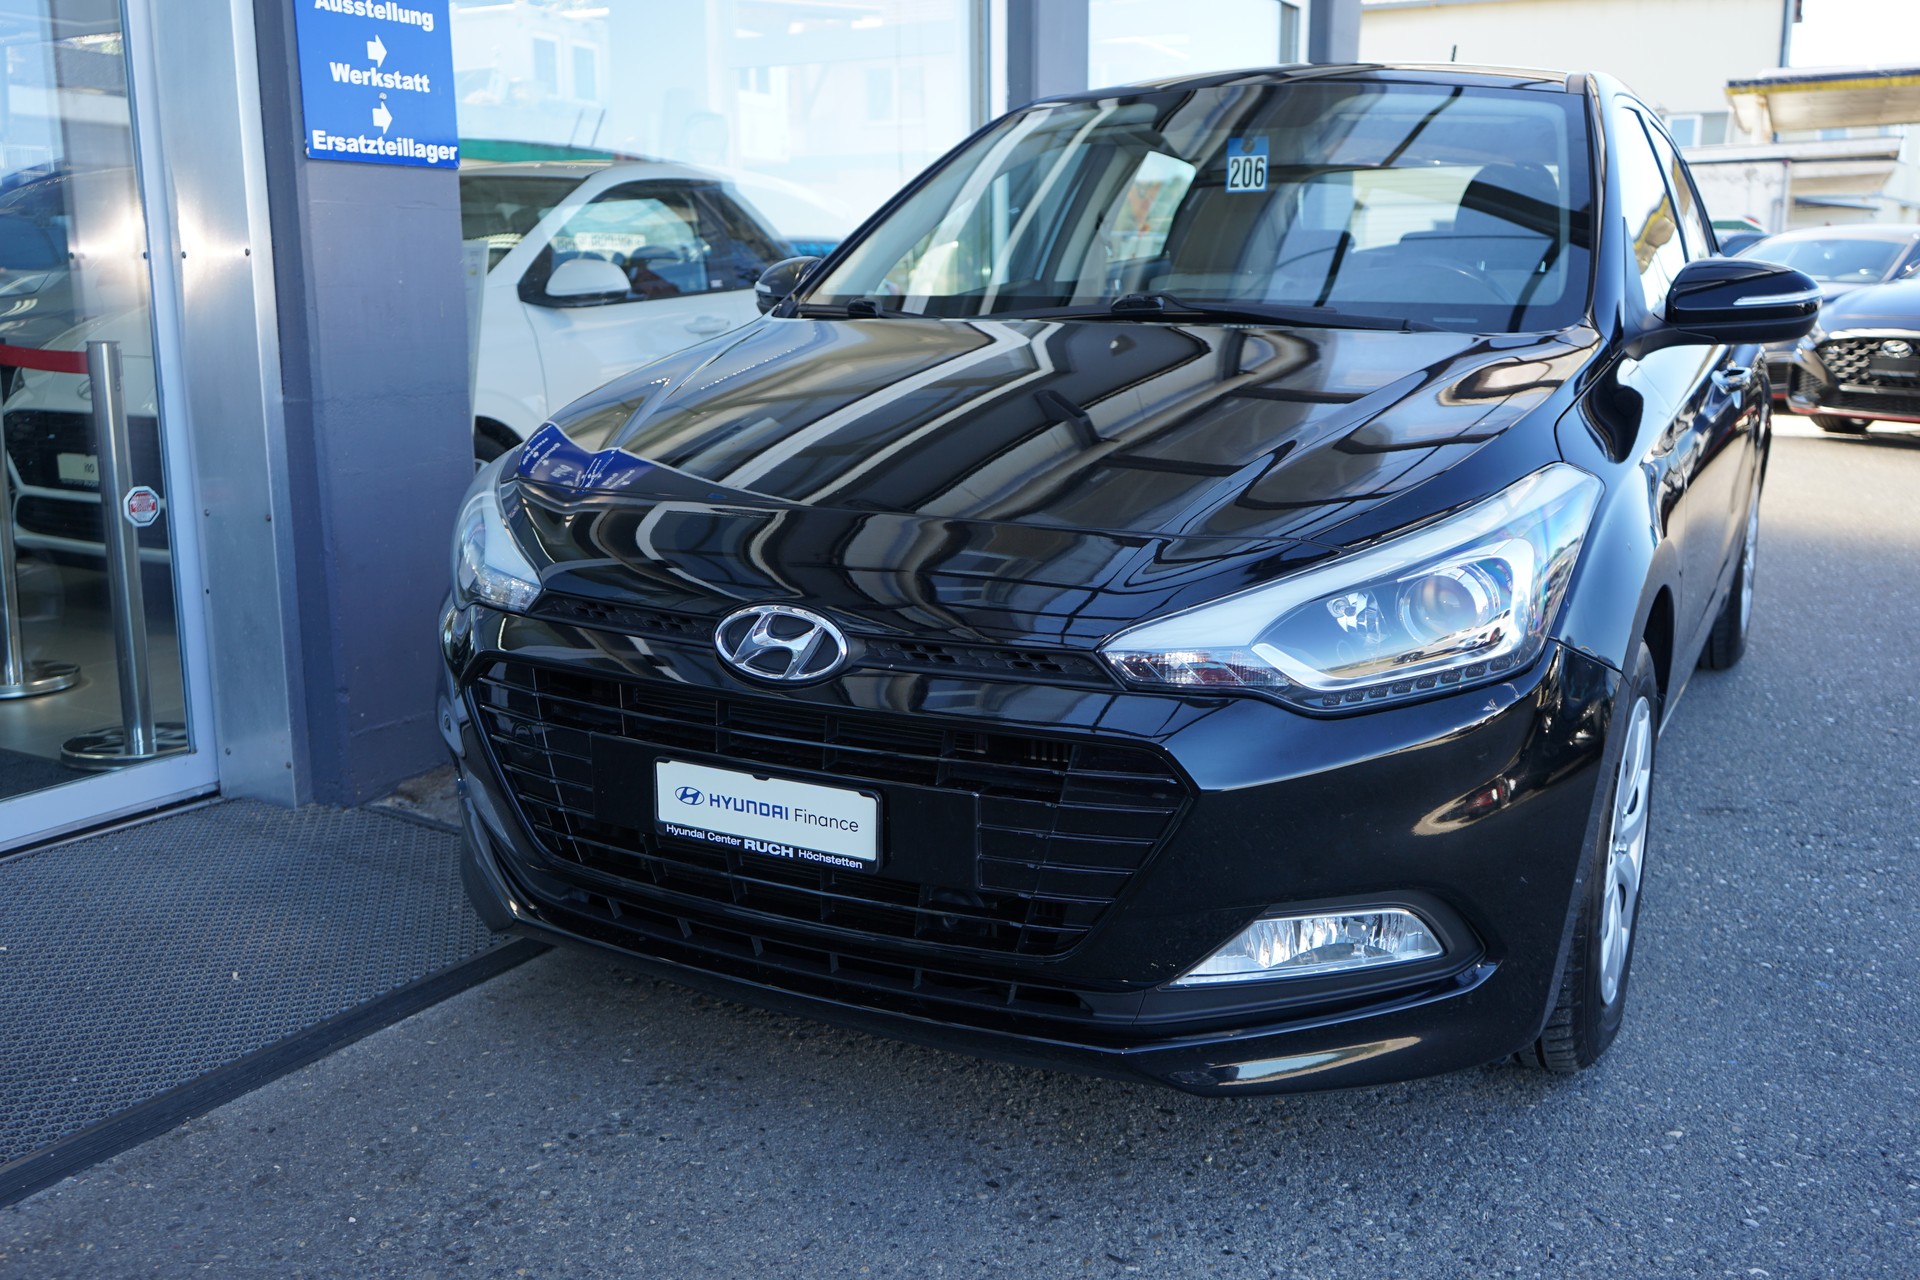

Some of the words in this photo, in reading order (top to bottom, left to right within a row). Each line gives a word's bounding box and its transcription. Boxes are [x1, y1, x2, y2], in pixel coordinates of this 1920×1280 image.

[329, 61, 431, 93] Werkstatt
[312, 129, 458, 164] Ersatzteillager
[1230, 157, 1265, 188] 206
[709, 793, 789, 821] HYUNDAI
[794, 808, 859, 833] Finance
[666, 823, 706, 839] Hyundai
[707, 832, 742, 846] Center
[744, 838, 794, 858] RUCH
[798, 849, 863, 869] Höchstetten
